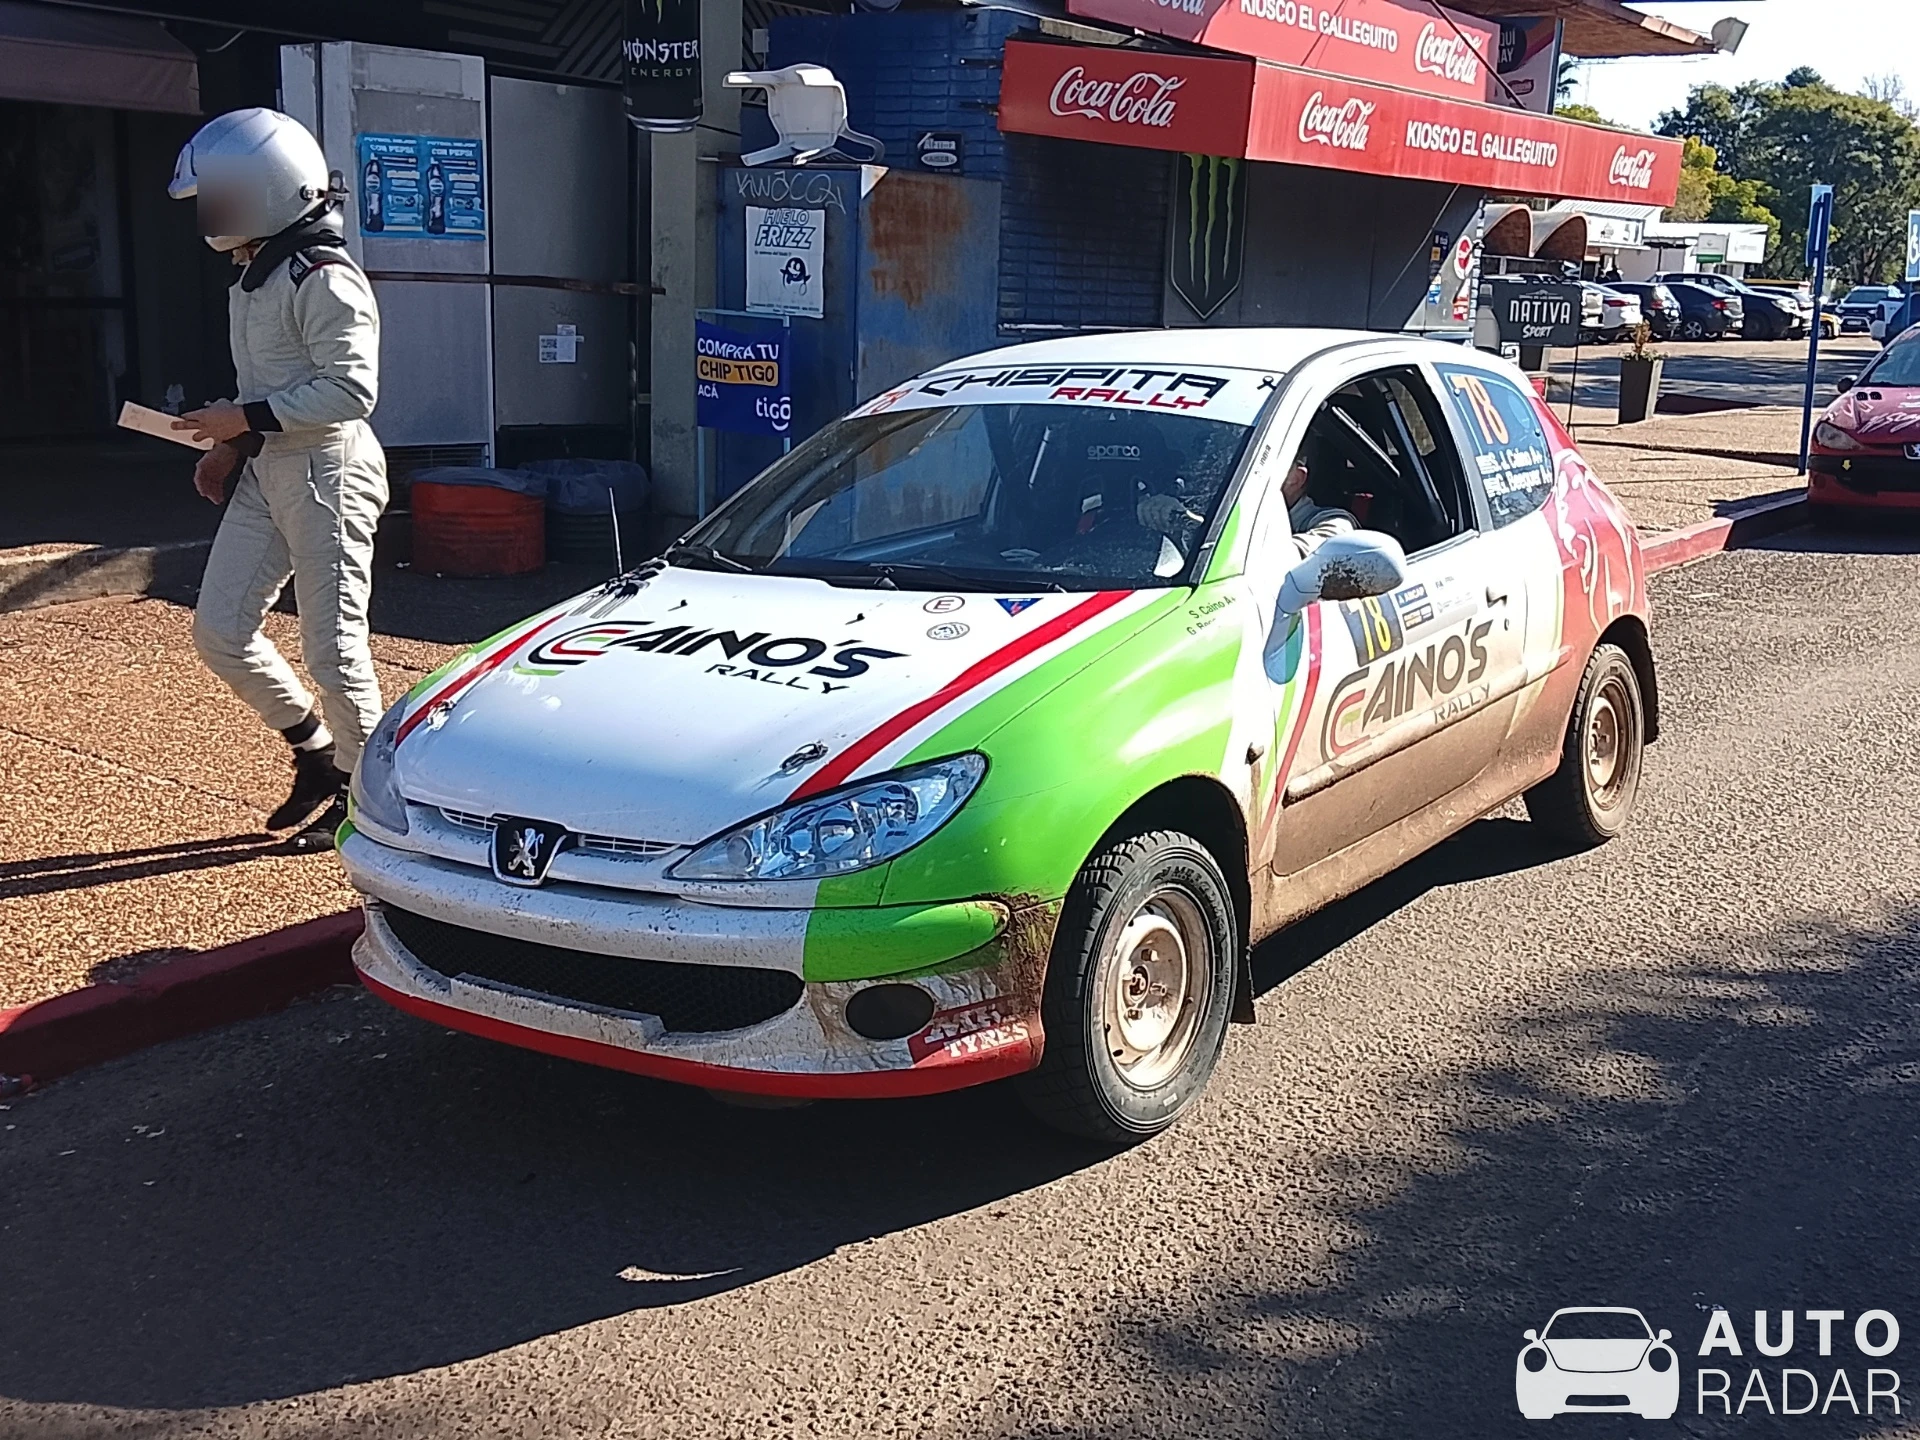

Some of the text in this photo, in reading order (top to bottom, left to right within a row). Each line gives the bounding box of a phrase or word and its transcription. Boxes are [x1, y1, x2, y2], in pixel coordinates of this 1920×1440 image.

[1299, 11, 1316, 31] EL
[1318, 12, 1398, 52] GALLEGUITO
[631, 67, 692, 77] ENERGY
[1050, 66, 1187, 128] Coca-Cola
[1298, 91, 1376, 151] Coca-Cola
[1405, 120, 1558, 168] KIOSCO EL GALLEGUITO
[1608, 145, 1657, 189] Coca-Cola
[755, 225, 816, 250] FRIZZ
[1509, 300, 1571, 324] NATIVA
[697, 337, 779, 360] COMPRA TU
[700, 360, 775, 383] CHIP TIGO
[917, 368, 1231, 399] CHISPITA
[1048, 387, 1207, 410] RALLY
[1450, 375, 1509, 445] 78
[1087, 445, 1141, 460] sparco
[704, 663, 851, 694] RALLY
[1434, 682, 1491, 725] RALLY
[943, 1020, 1030, 1058] TYRES
